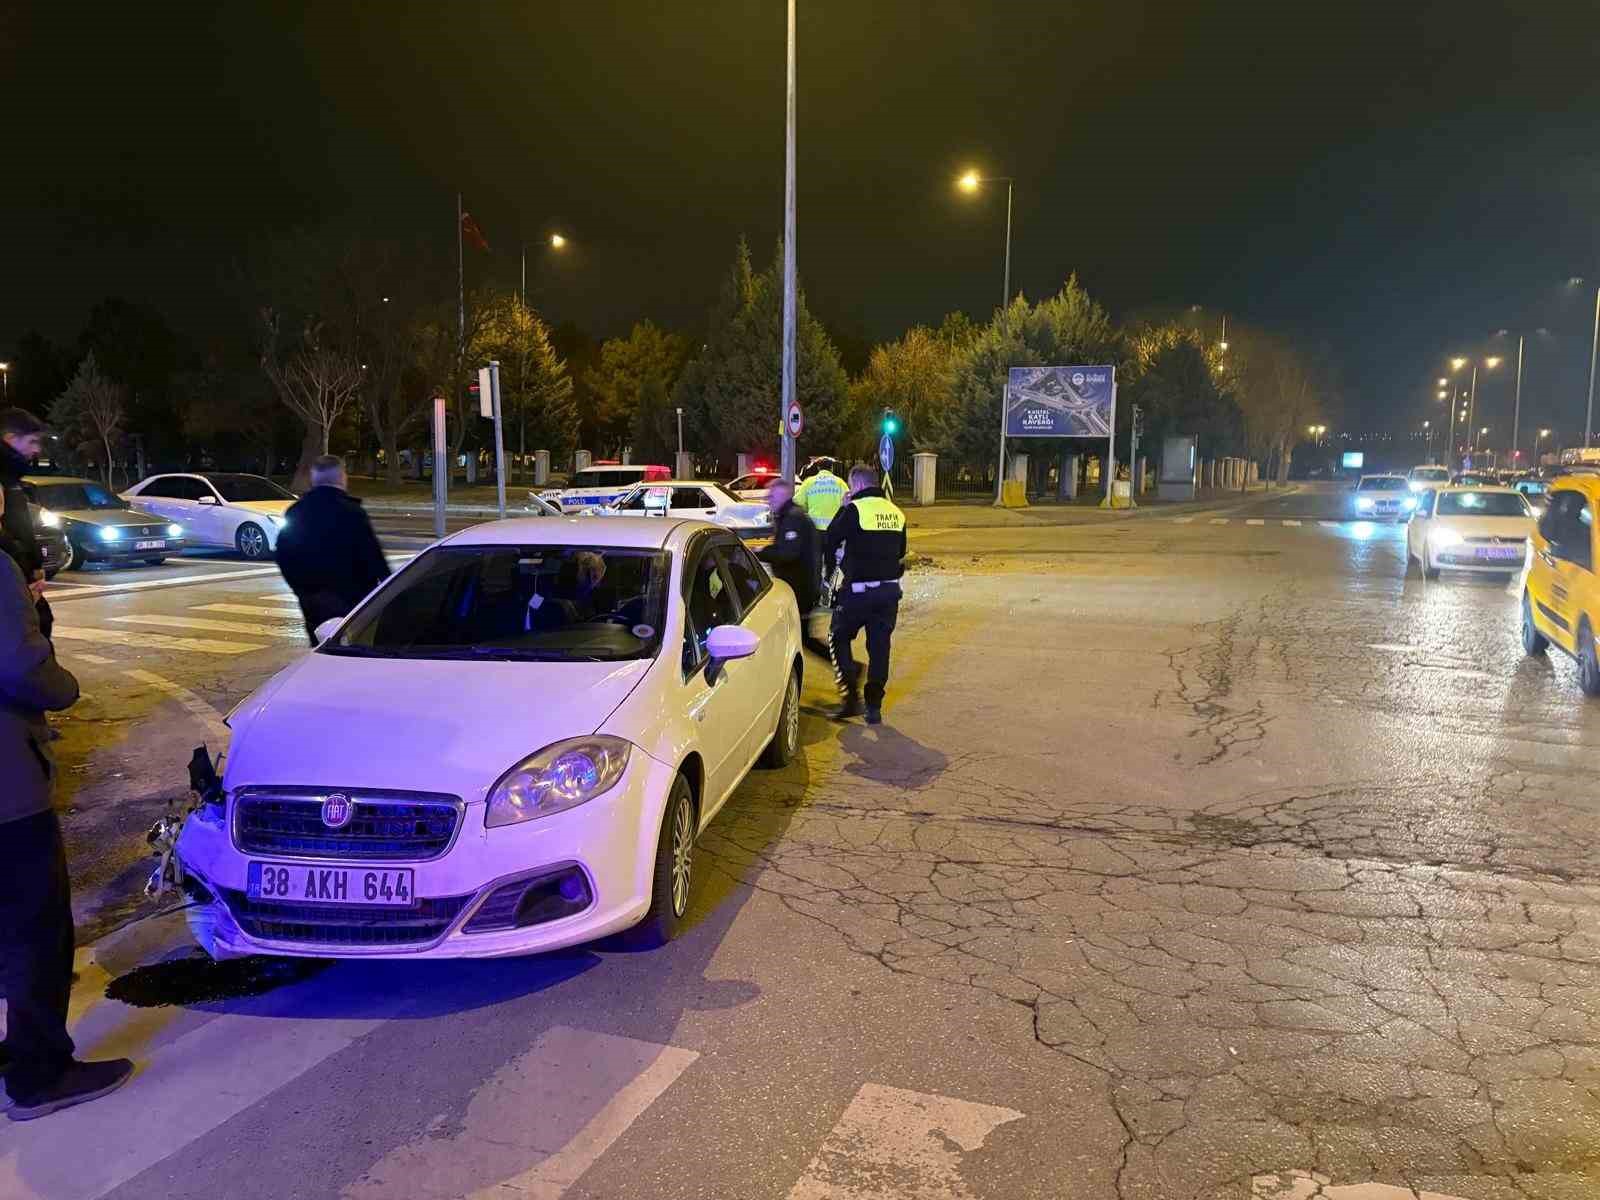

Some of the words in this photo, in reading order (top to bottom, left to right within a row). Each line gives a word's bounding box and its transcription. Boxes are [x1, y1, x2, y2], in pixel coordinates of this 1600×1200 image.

[327, 804, 344, 820] FIAT
[263, 867, 289, 896] 38
[304, 870, 348, 900] AKH
[364, 872, 409, 902] 644
